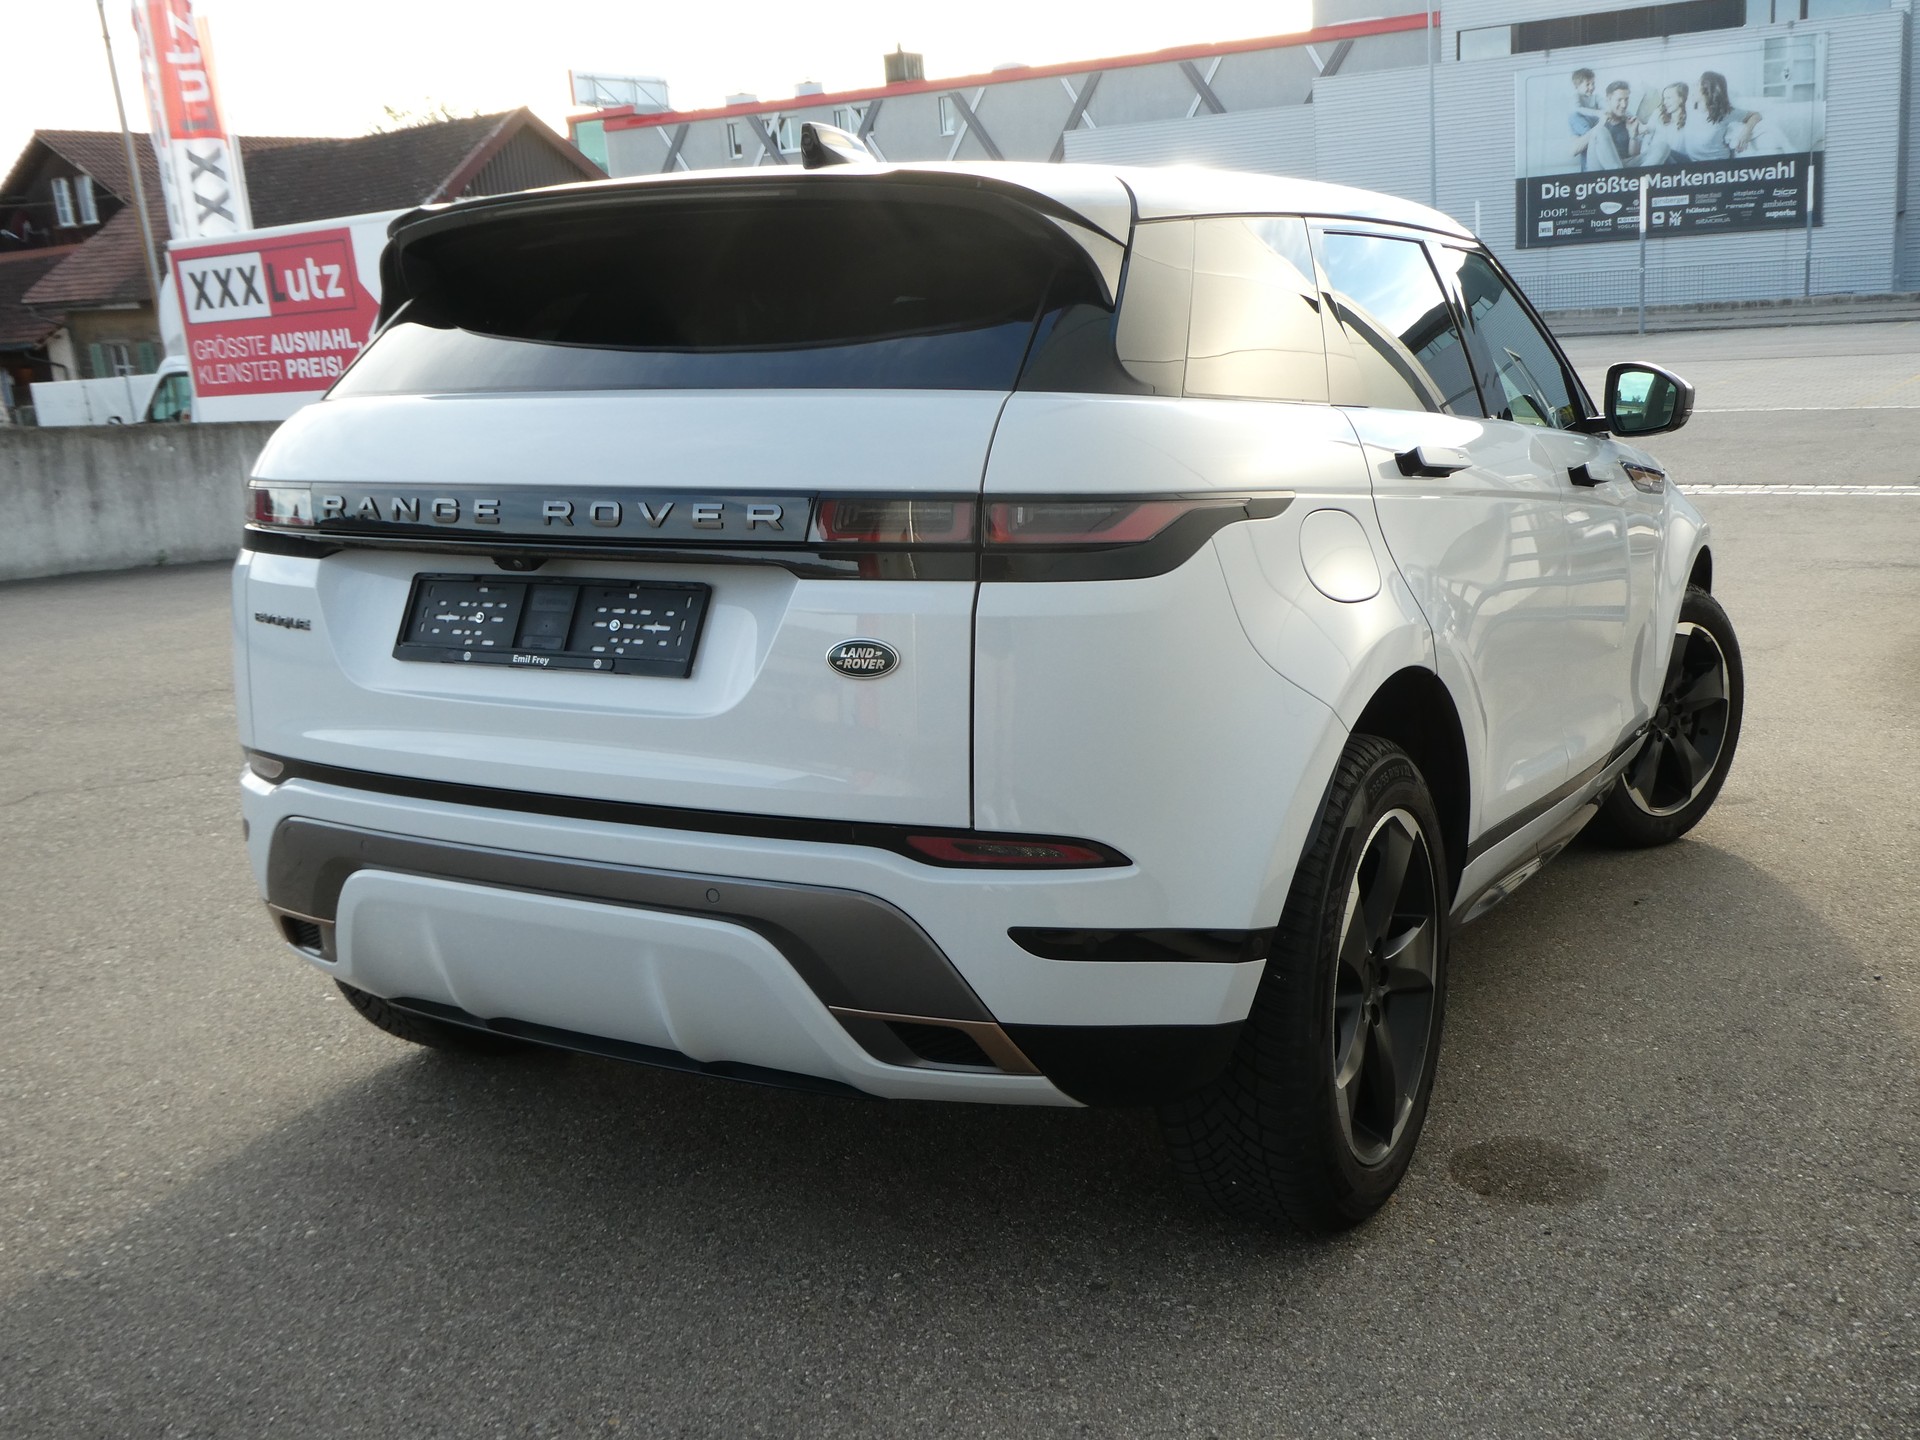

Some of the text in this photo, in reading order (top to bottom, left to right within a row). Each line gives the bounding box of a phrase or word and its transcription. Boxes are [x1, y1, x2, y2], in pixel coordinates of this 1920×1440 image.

[1541, 160, 1795, 201] Die größte Markenauswahl
[1538, 208, 1568, 219] JOOP!
[1591, 218, 1612, 228] horst
[193, 328, 363, 360] GRÖSSTE AUSWAHL,
[198, 356, 344, 385] KLEINSTER PREIS!
[322, 495, 784, 532] RANGE ROVER
[840, 647, 875, 658] LAND
[512, 654, 550, 666] Emil Frey
[843, 658, 885, 670] ROVER
